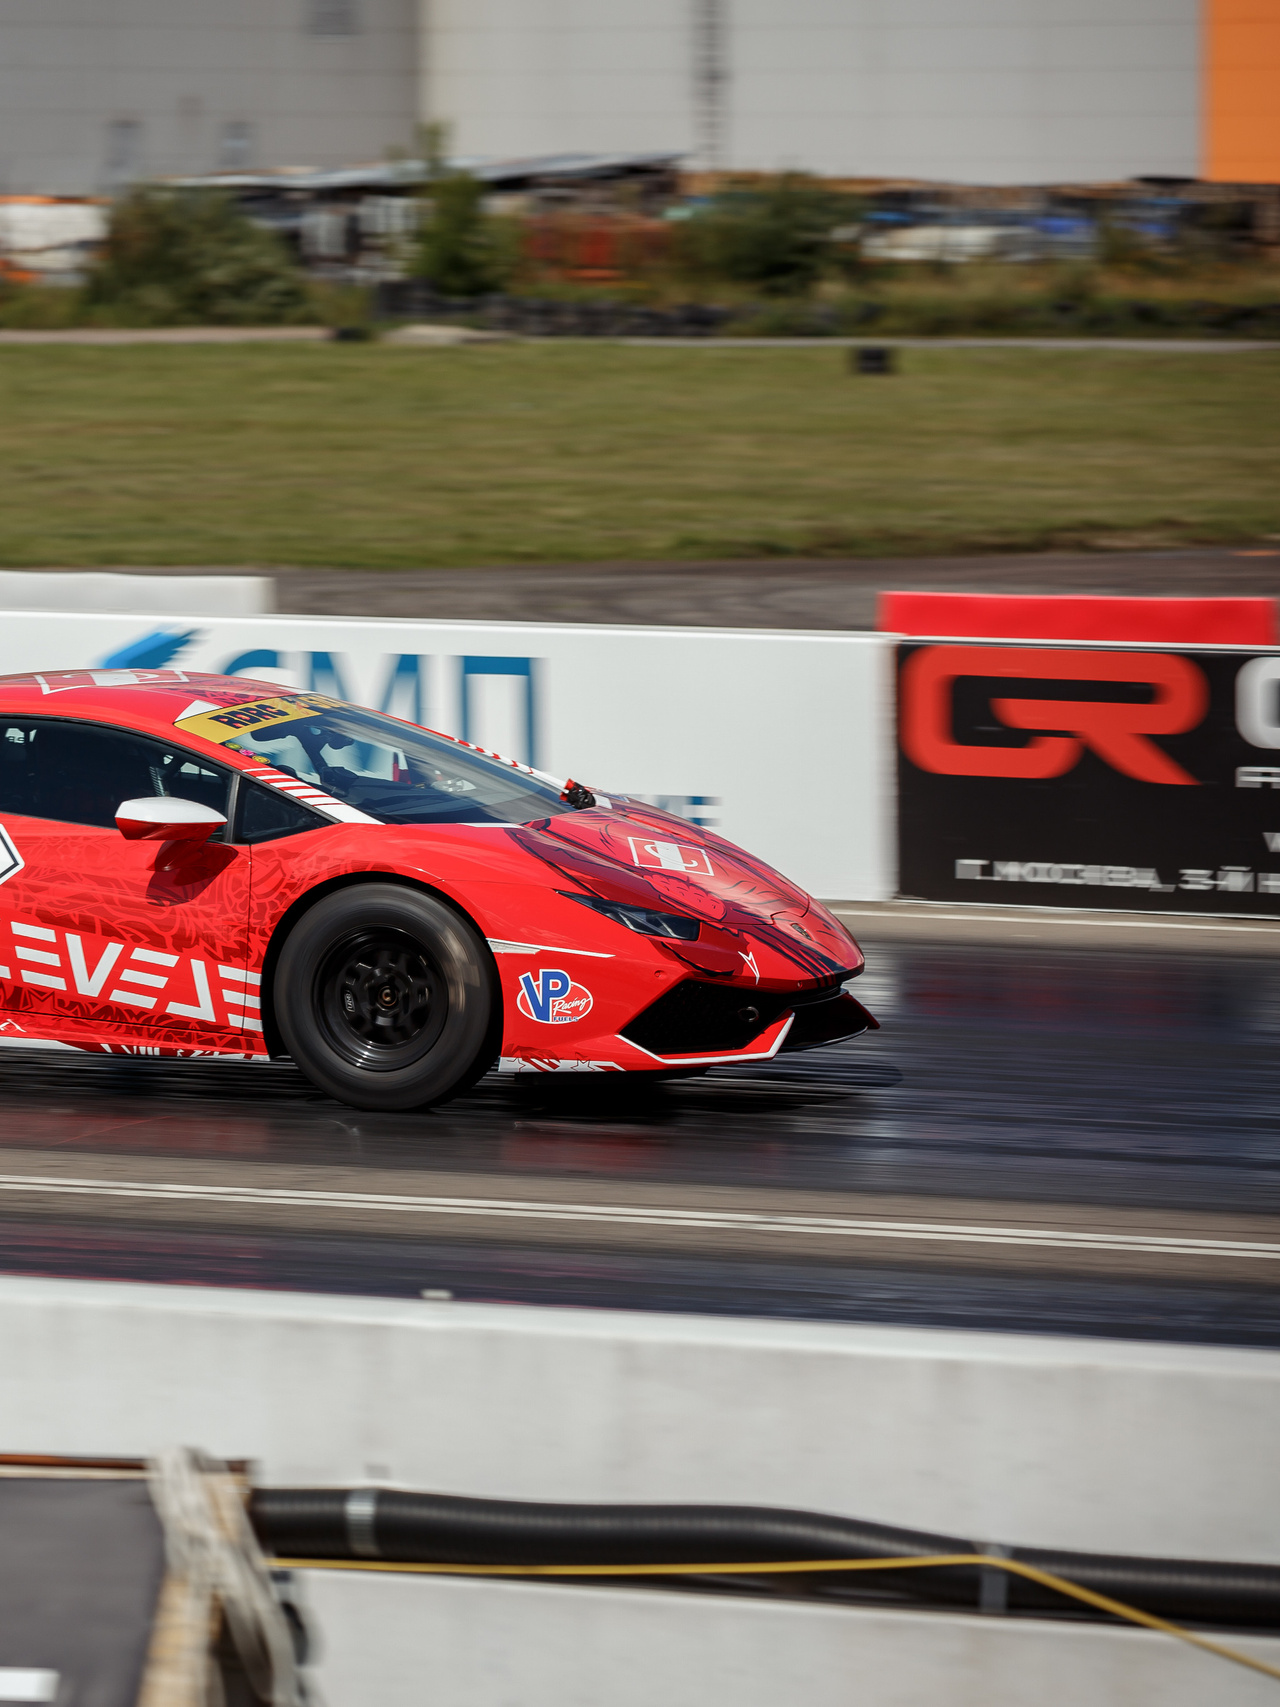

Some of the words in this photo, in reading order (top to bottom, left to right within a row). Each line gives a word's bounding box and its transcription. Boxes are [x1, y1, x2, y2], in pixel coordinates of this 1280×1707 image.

[207, 704, 290, 729] RDRC
[222, 648, 546, 770] МП
[518, 969, 572, 1023] VP
[553, 997, 592, 1016] Racing
